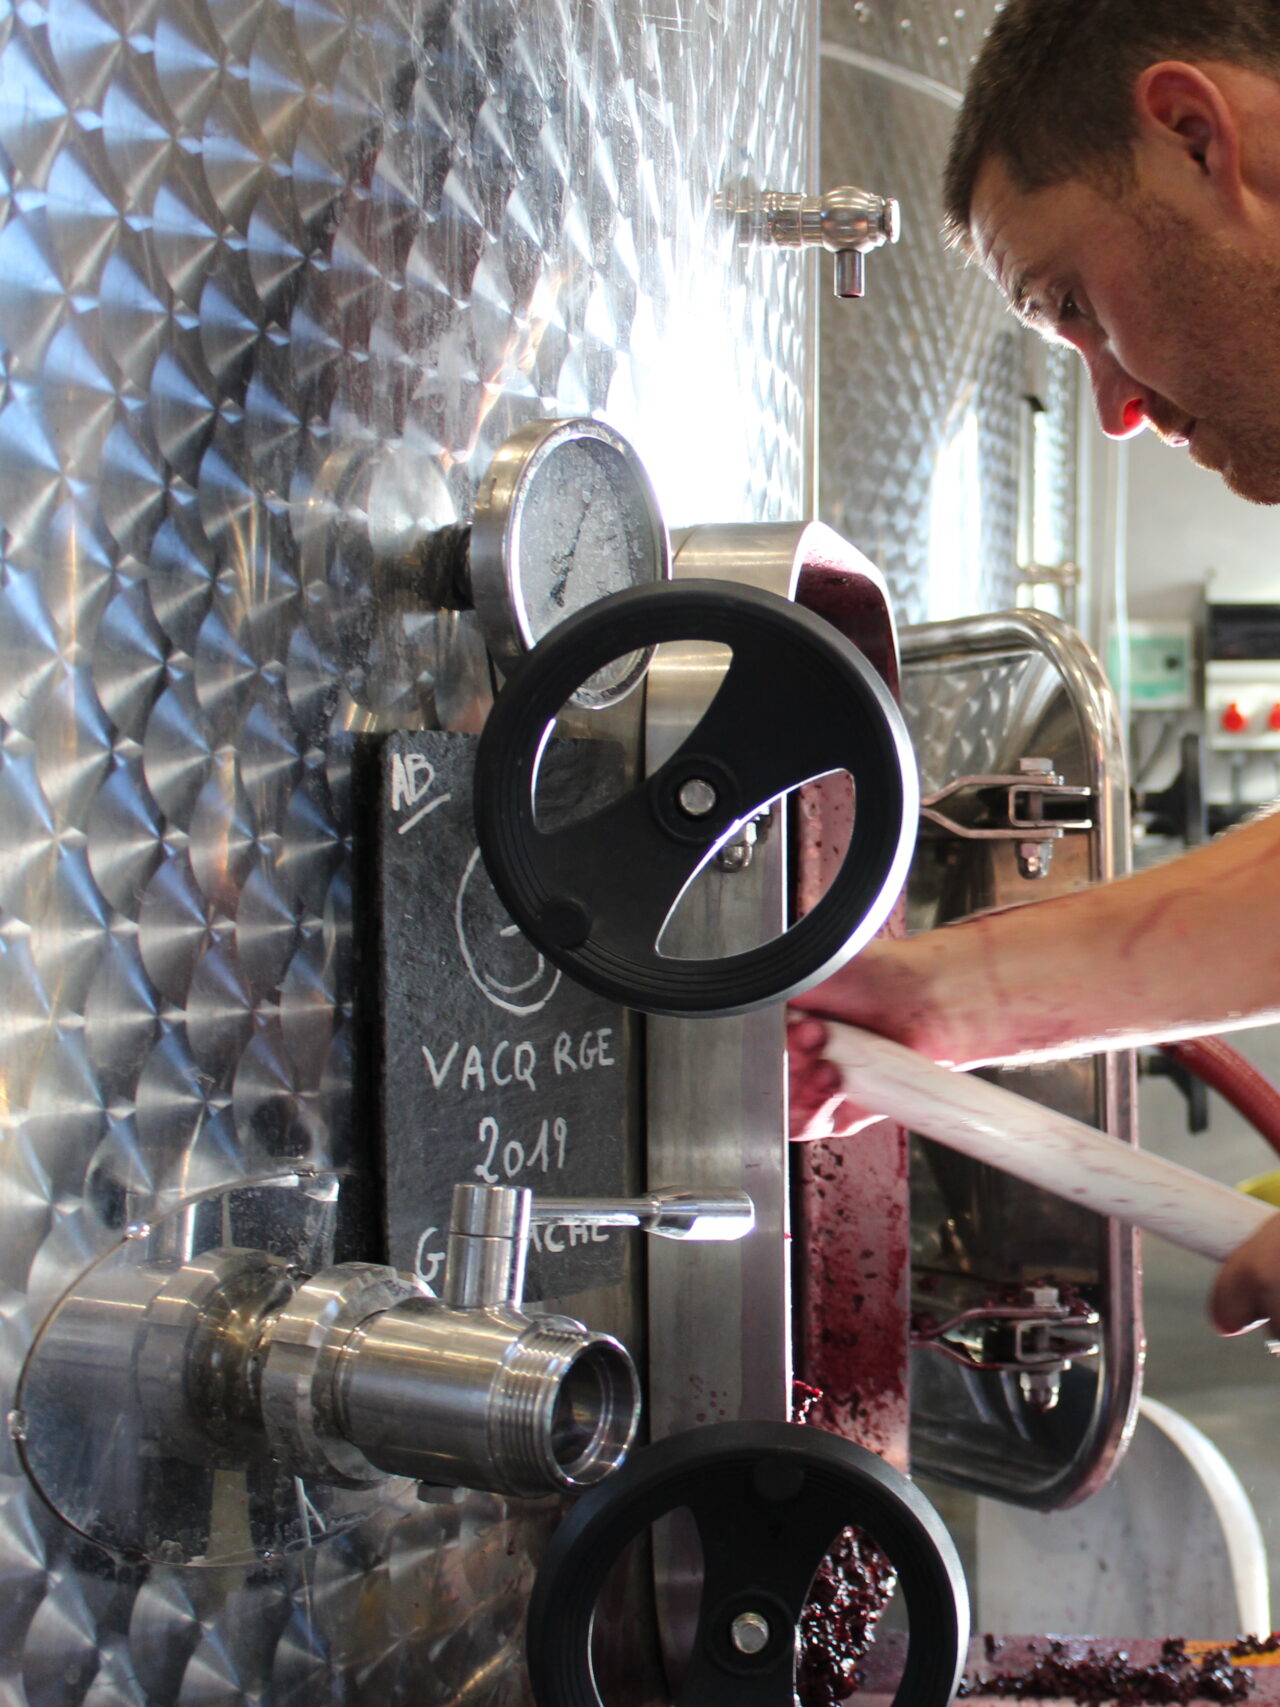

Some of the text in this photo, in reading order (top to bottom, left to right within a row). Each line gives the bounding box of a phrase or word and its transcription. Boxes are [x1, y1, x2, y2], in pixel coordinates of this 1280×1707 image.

[421, 1027, 616, 1092] VACQ RGE
[473, 1115, 569, 1184] 2019
